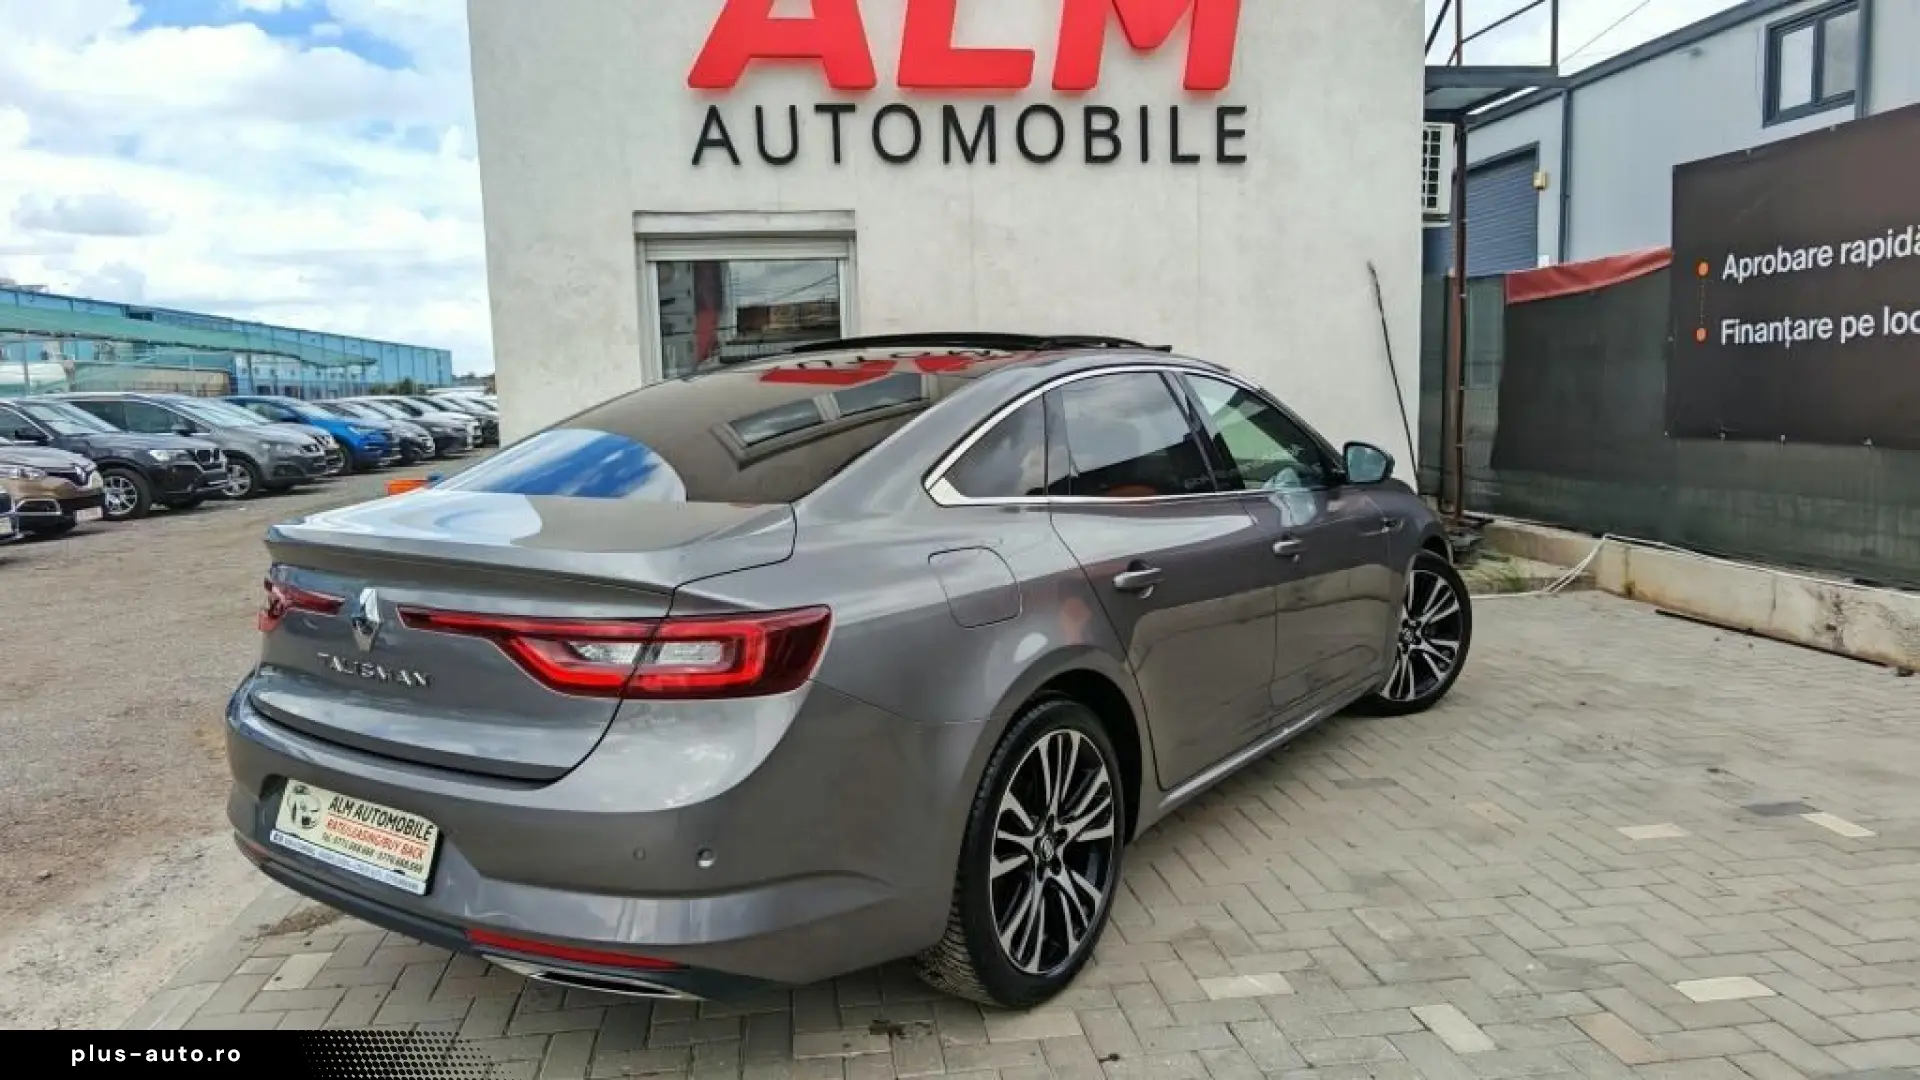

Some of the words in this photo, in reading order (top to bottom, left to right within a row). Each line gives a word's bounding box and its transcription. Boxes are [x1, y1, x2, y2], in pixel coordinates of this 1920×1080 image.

[687, 0, 1240, 92] ALM
[691, 104, 1247, 165] AUTOMOBILE
[1722, 245, 1833, 284] Aprobare
[1721, 316, 1833, 349] Finanțare
[1840, 314, 1876, 344] pe
[317, 652, 432, 687] TALISMAN
[328, 796, 355, 818] ALM
[354, 803, 434, 841] AUTOMOBILE
